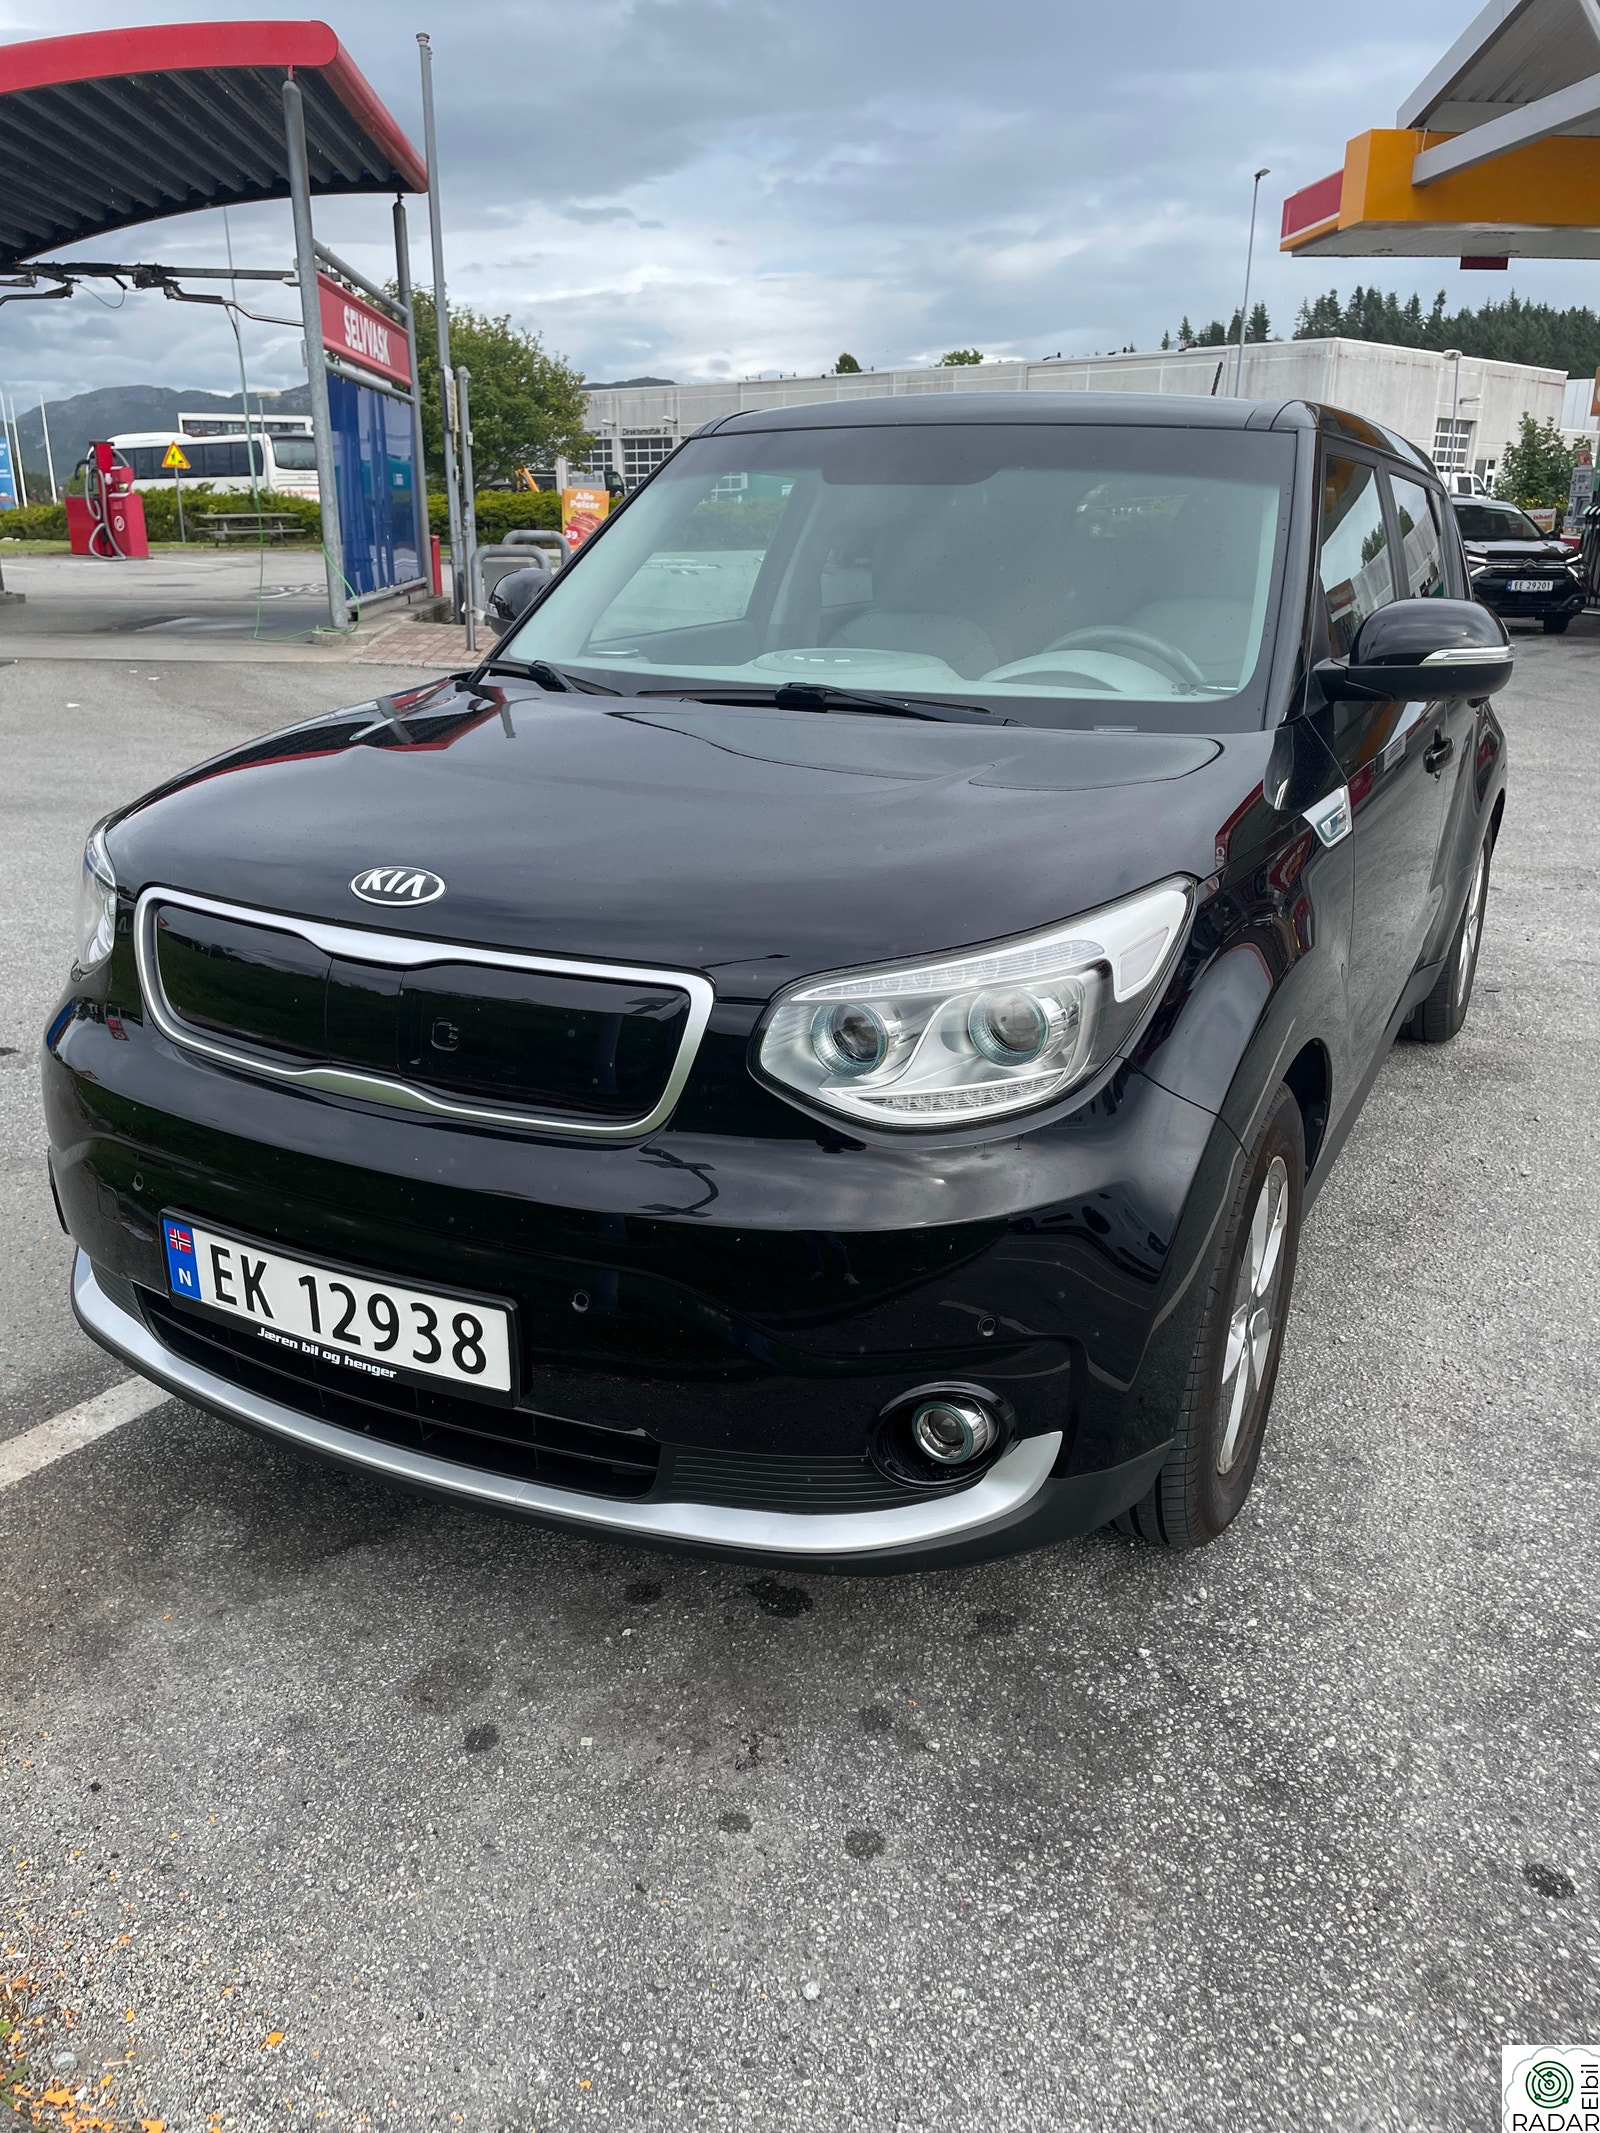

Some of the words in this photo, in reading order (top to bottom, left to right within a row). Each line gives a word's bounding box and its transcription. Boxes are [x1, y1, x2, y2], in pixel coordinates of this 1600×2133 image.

[343, 305, 391, 366] SELVVASK
[663, 426, 668, 435] 2
[575, 492, 595, 501] Alle
[1514, 581, 1524, 589] EE
[1526, 581, 1550, 589] 29201
[360, 869, 427, 898] KIA
[178, 1267, 192, 1287] N
[209, 1243, 275, 1319] EK
[298, 1274, 487, 1375] 12938
[257, 1327, 299, 1349] Jæren
[301, 1341, 319, 1356] bil
[322, 1350, 341, 1365] og
[344, 1355, 397, 1378] henger
